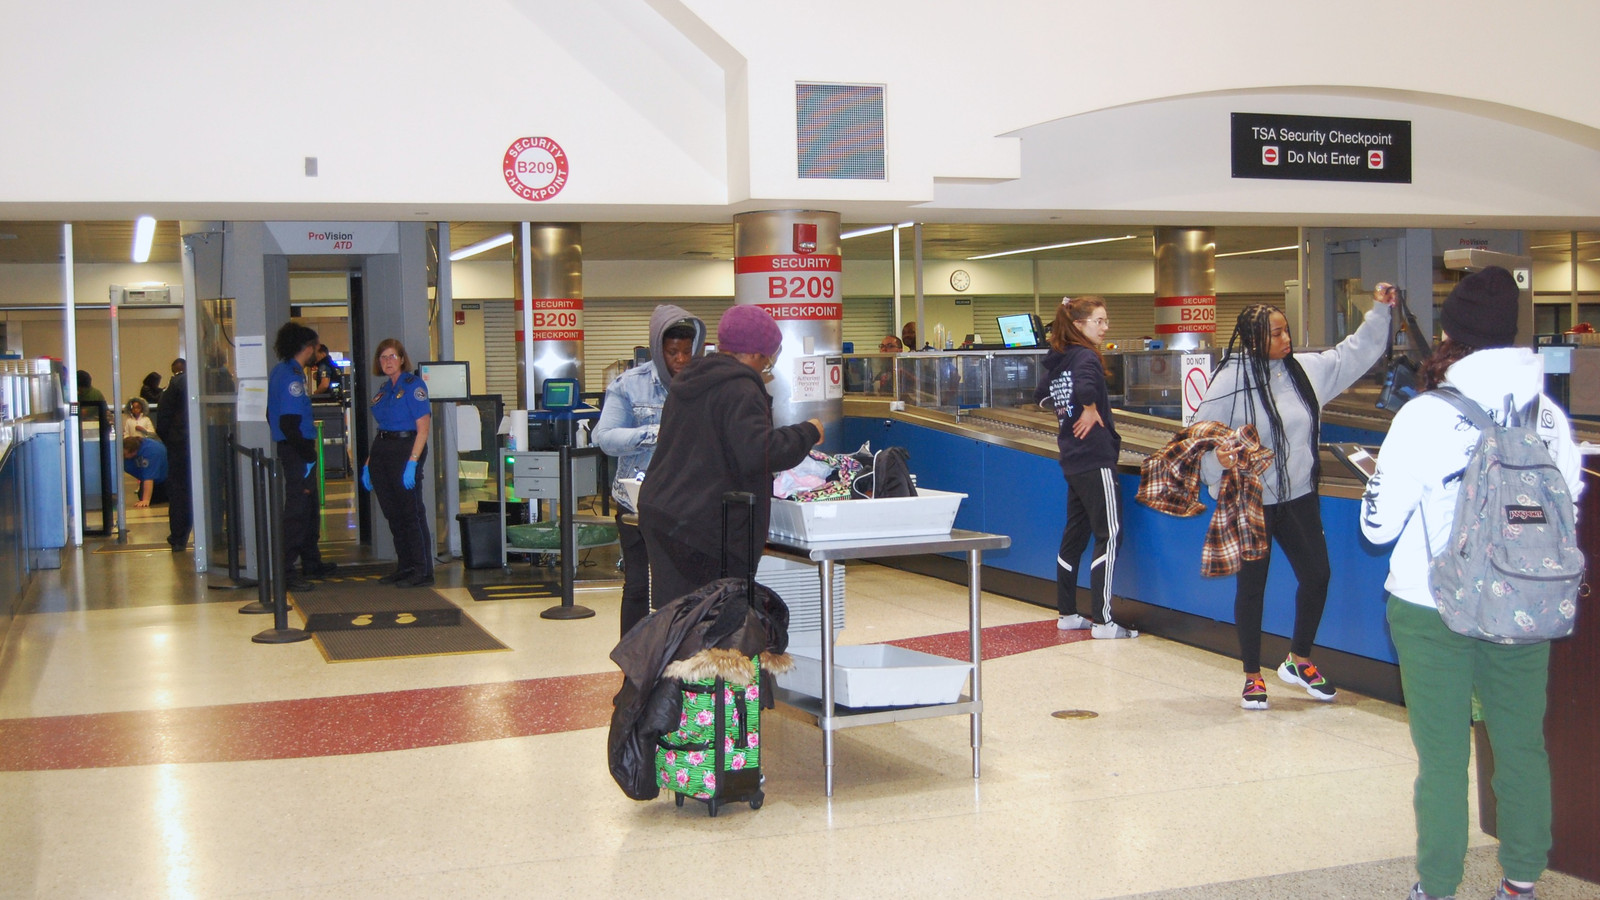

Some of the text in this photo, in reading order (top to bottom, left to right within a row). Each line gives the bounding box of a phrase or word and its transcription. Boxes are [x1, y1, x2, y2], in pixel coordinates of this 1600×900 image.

[1252, 127, 1392, 147] TSA Security Checkpoint
[509, 137, 564, 158] SECURITY
[1287, 151, 1360, 165] Do Not Enter
[517, 161, 554, 173] B209
[505, 169, 567, 199] CHECKPOINT
[308, 231, 353, 240] ProVision
[333, 241, 353, 250] ATD
[772, 258, 830, 268] SECURITY
[1516, 272, 1524, 283] 6
[768, 276, 834, 298] B209
[535, 300, 574, 308] SECURITY
[533, 312, 577, 327] B209
[1181, 308, 1215, 321] B209
[1186, 357, 1205, 365] DO NOT
